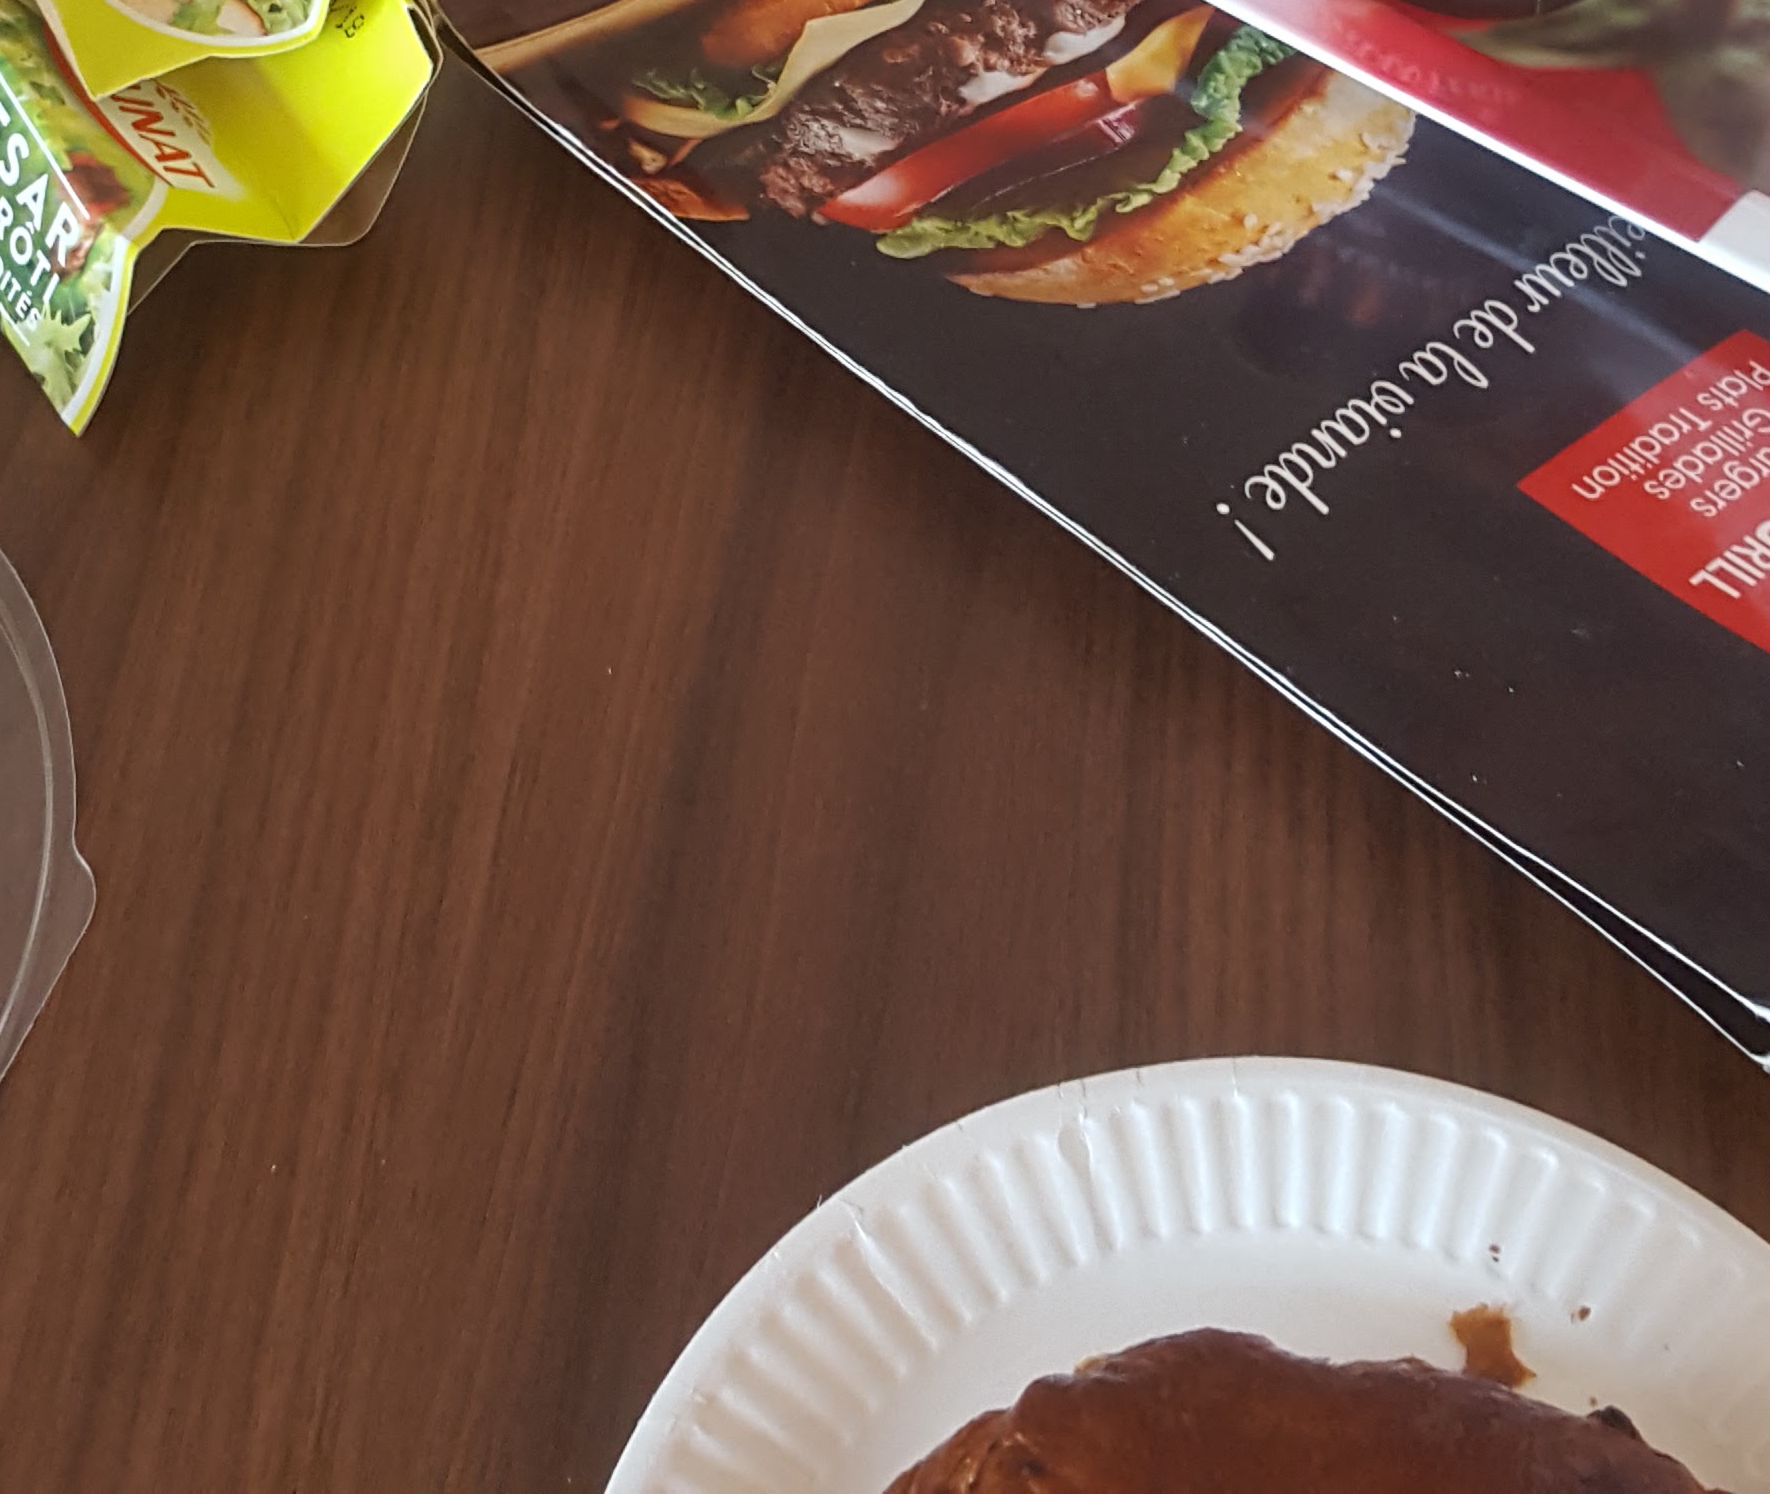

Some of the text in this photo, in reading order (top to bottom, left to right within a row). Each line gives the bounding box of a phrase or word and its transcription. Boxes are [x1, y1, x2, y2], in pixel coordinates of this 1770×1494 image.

[110, 85, 215, 188] NAT
[1216, 215, 1647, 561] eilleur de la viande !
[1571, 407, 1713, 500] Tradition
